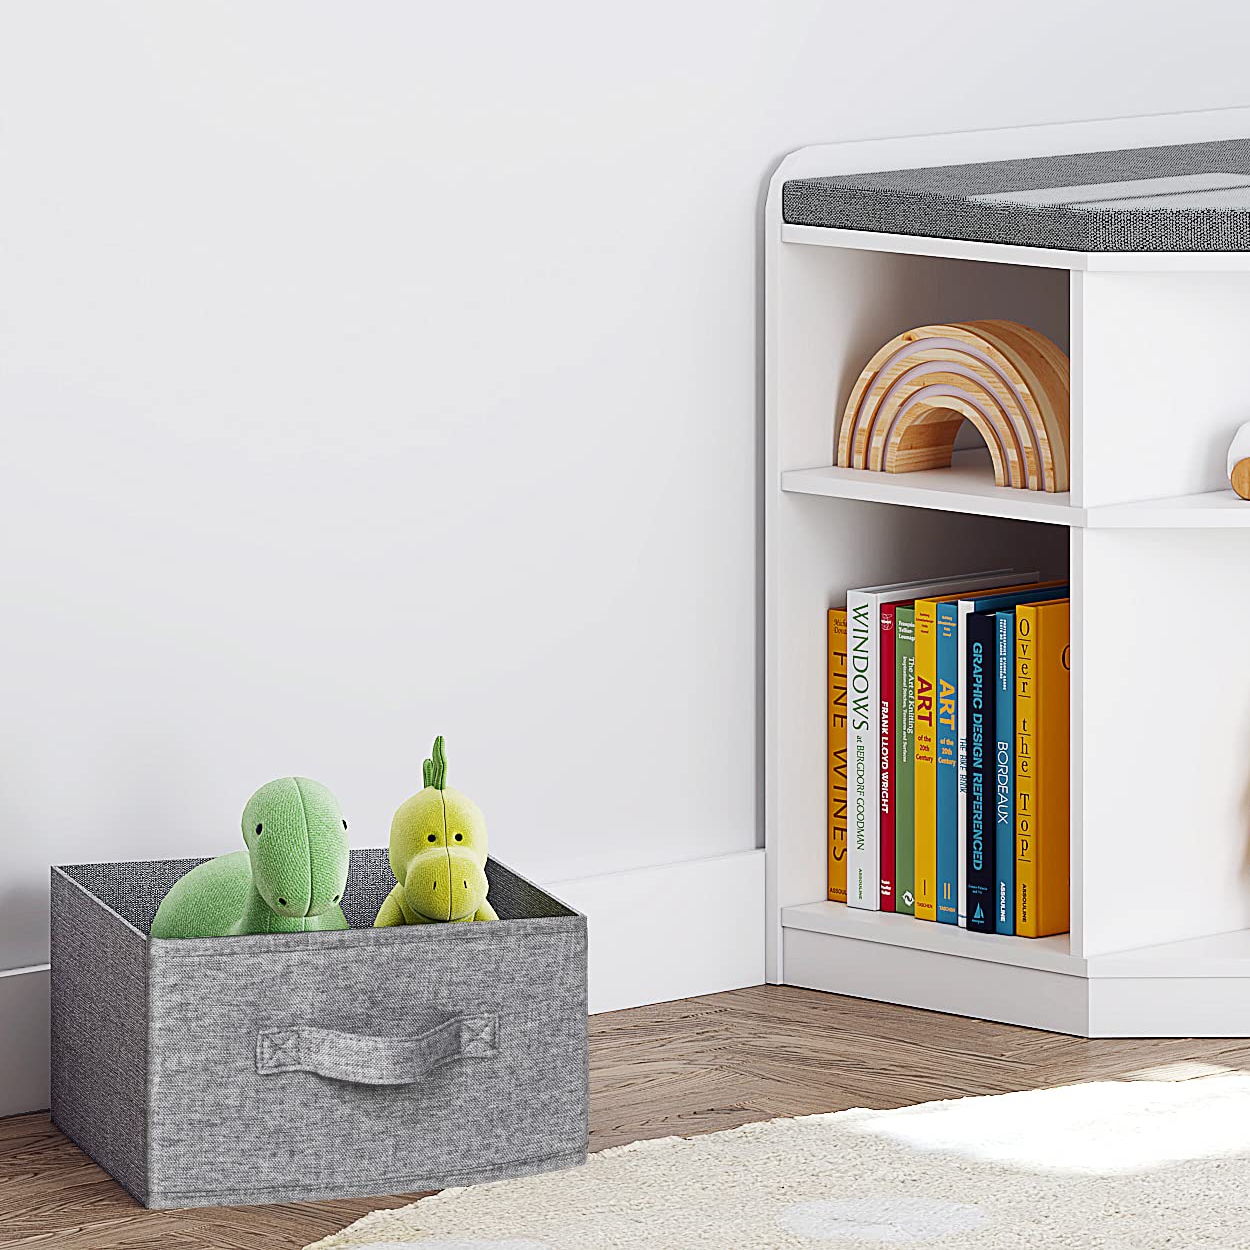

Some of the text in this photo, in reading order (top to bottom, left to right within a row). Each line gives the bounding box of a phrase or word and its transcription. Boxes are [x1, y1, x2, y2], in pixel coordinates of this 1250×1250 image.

[852, 604, 869, 730] WINDOWS
[908, 690, 914, 699] of
[918, 676, 932, 727] ART
[940, 678, 955, 730] ART
[833, 652, 847, 862] FINE WINES
[916, 754, 933, 763] Century
[973, 642, 983, 870] GRAPHIC DESIGN REFERENCED
[1020, 618, 1030, 856] Over the Top
[998, 742, 1008, 824] BORDEAUX
